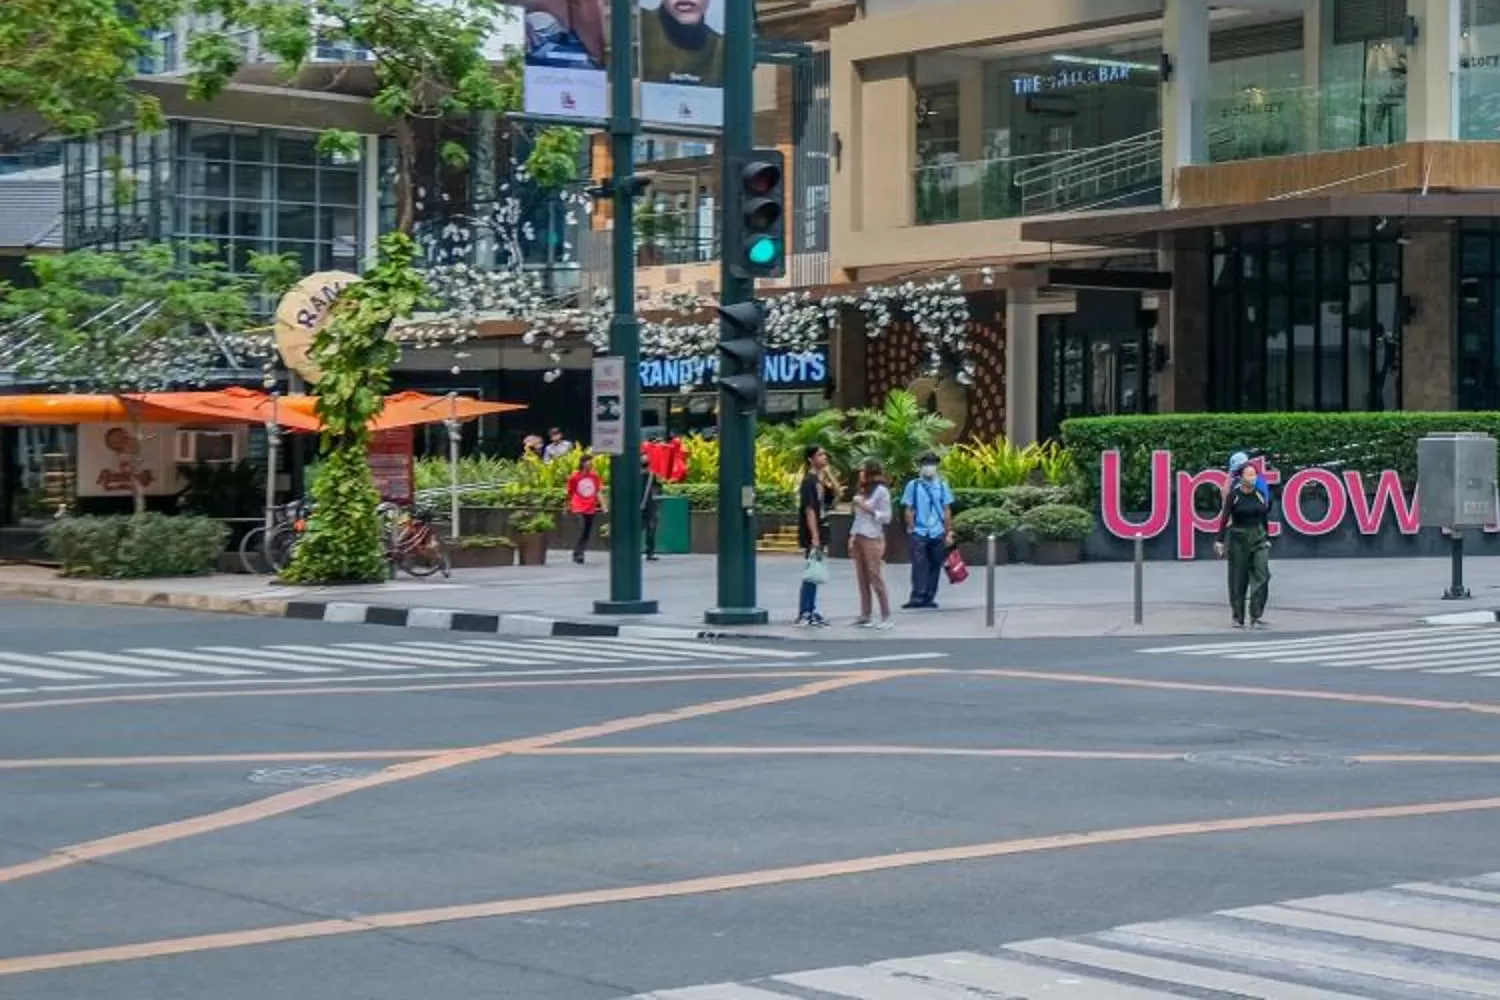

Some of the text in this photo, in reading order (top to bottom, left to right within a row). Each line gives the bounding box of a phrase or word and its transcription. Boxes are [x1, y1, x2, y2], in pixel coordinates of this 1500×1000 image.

[1012, 74, 1042, 96] THE
[1098, 63, 1130, 83] BAR
[1101, 449, 1500, 560] Upow
